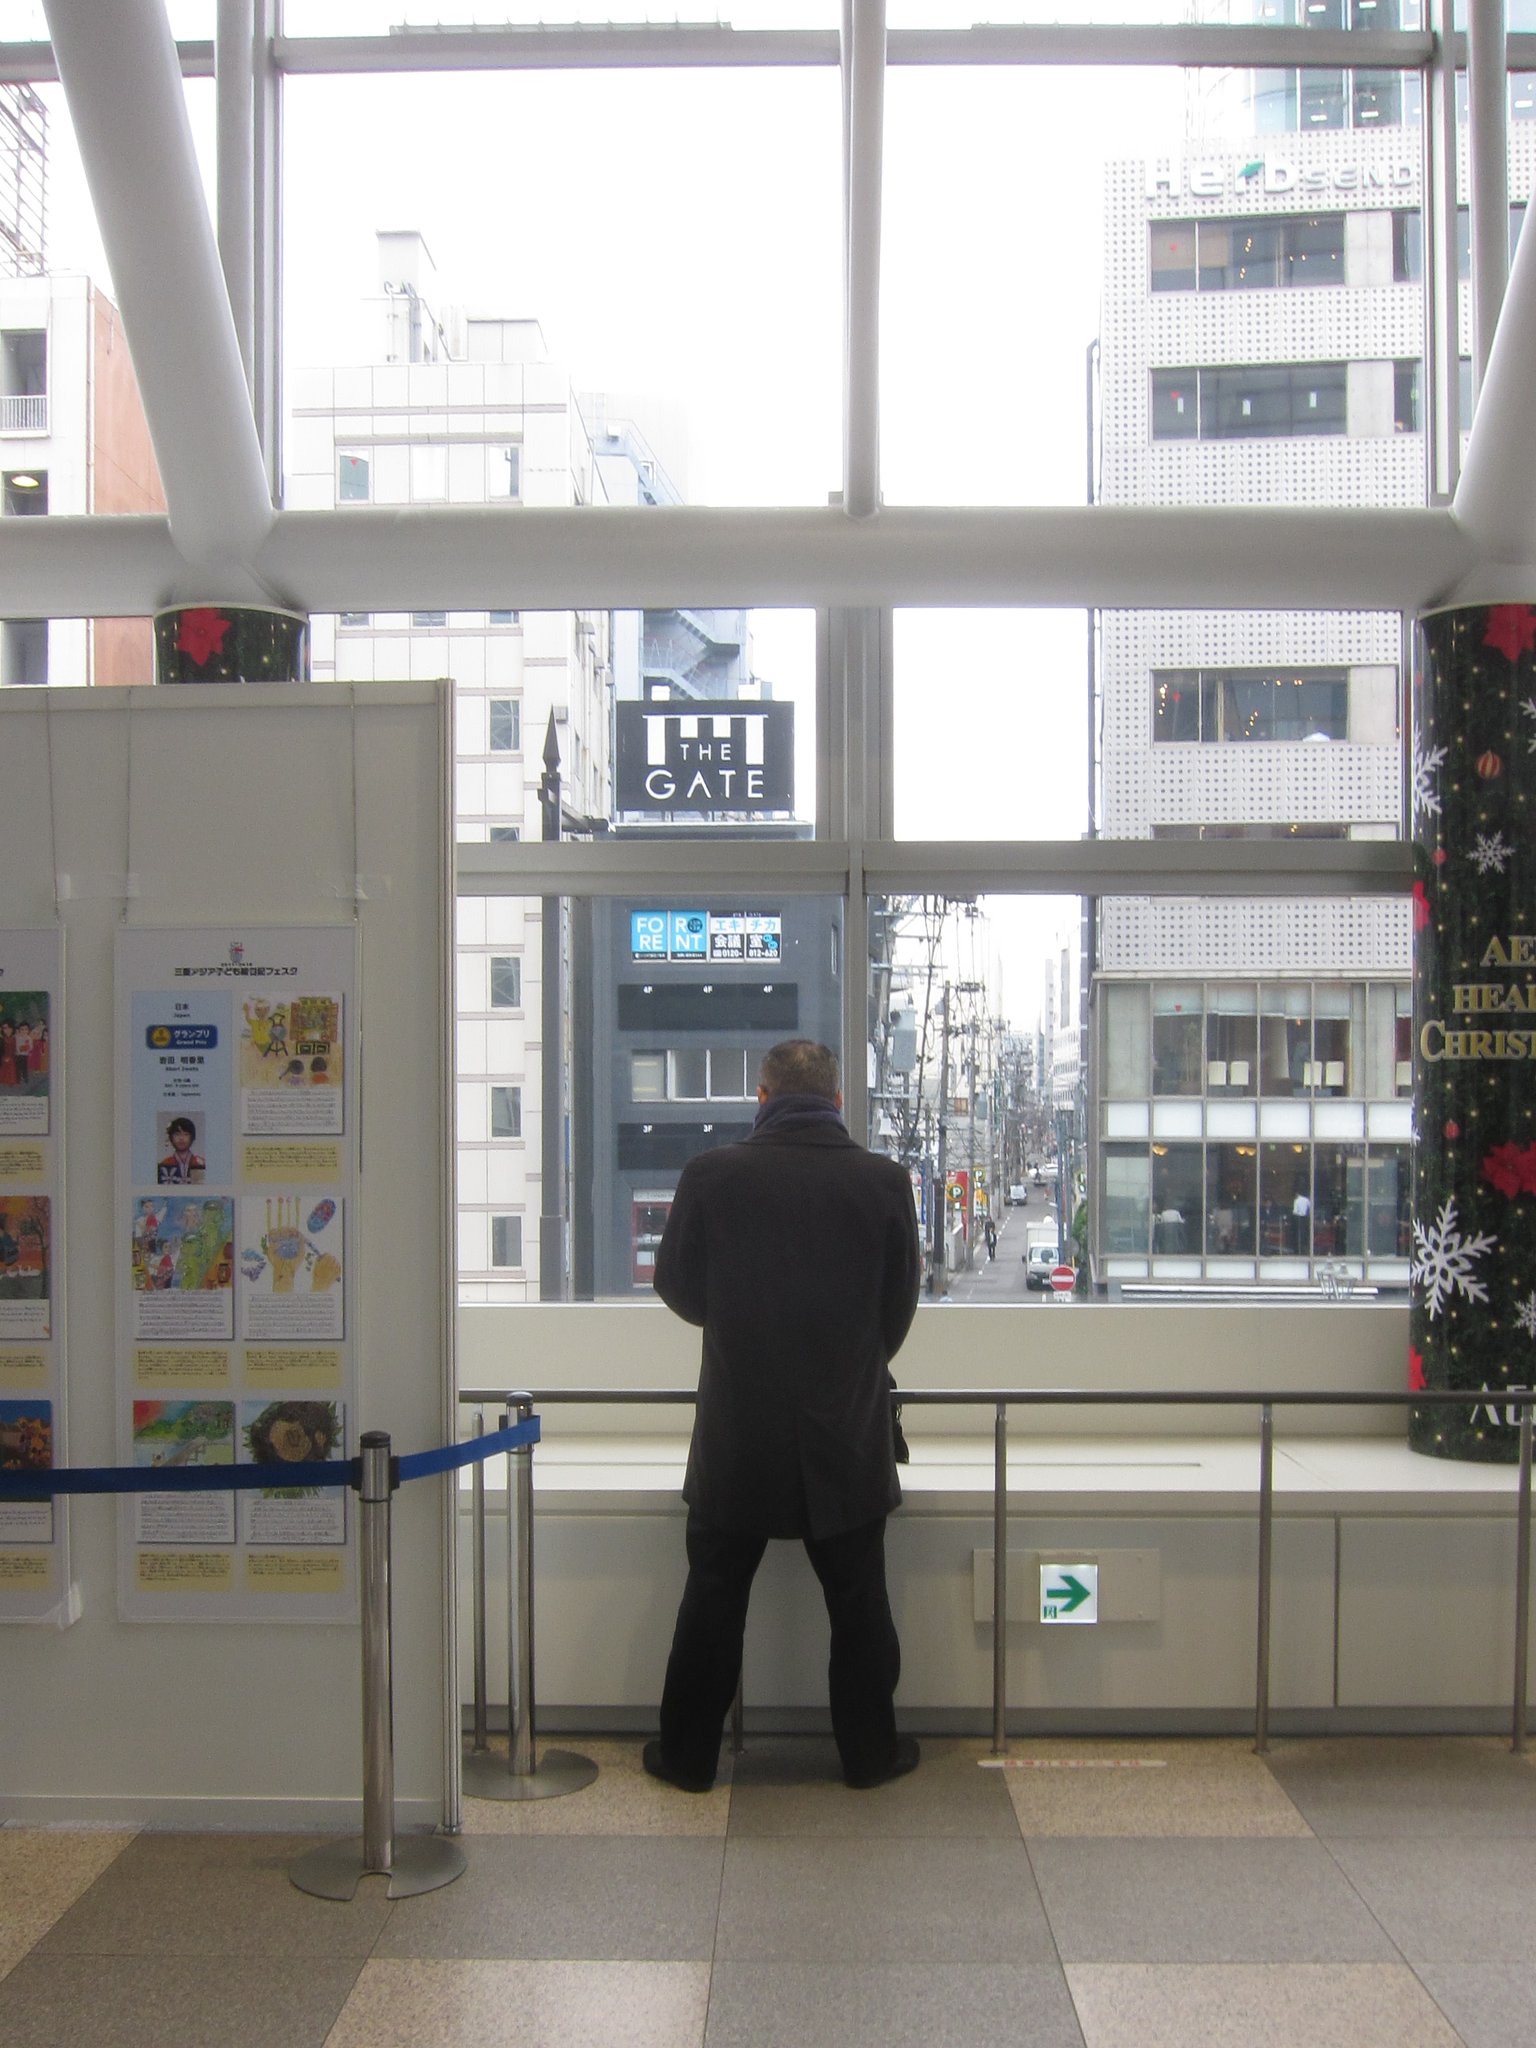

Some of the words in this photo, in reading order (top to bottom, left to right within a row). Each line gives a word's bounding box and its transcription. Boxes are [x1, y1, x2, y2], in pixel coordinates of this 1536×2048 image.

[680, 743, 731, 761] THE
[645, 769, 764, 800] GATE
[1479, 935, 1536, 967] AE
